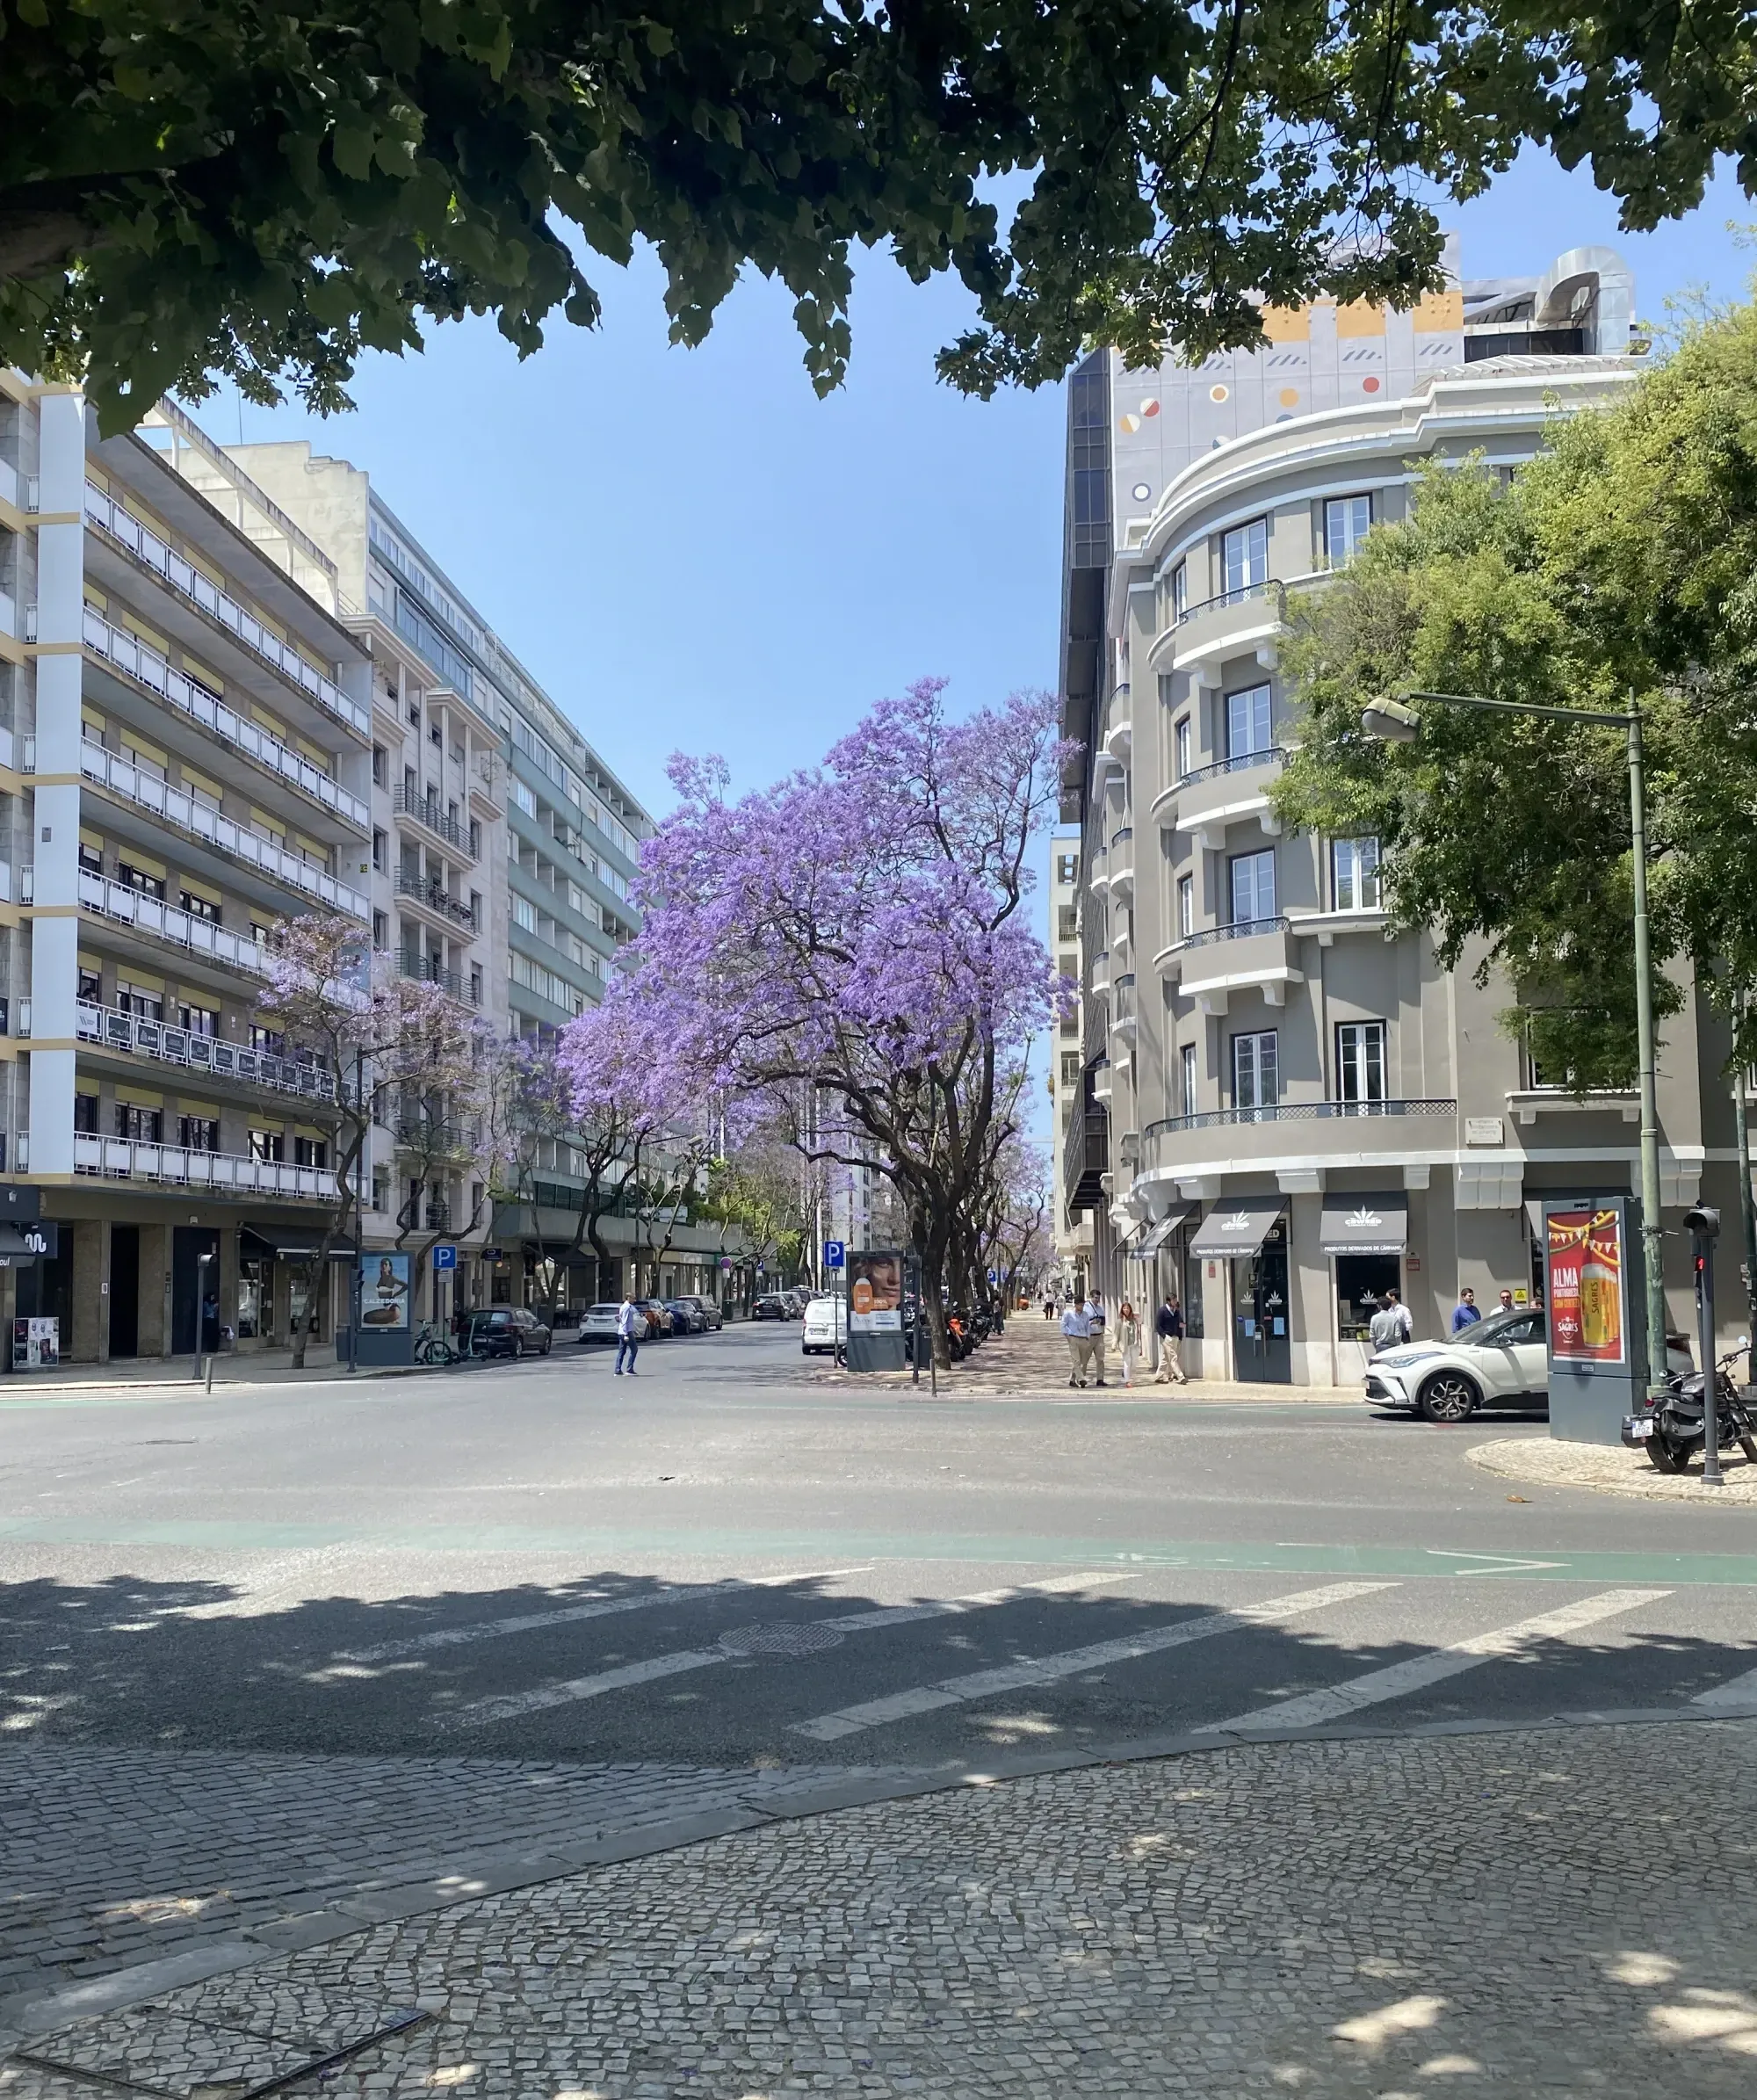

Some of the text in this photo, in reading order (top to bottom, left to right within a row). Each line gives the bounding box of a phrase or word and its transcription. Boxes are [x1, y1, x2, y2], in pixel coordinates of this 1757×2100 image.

[439, 1249, 451, 1266] P
[828, 1243, 840, 1264] P
[1553, 1268, 1579, 1287] ALMA
[1591, 1282, 1600, 1314] SAGRES
[1558, 1322, 1579, 1332] SAGRES
